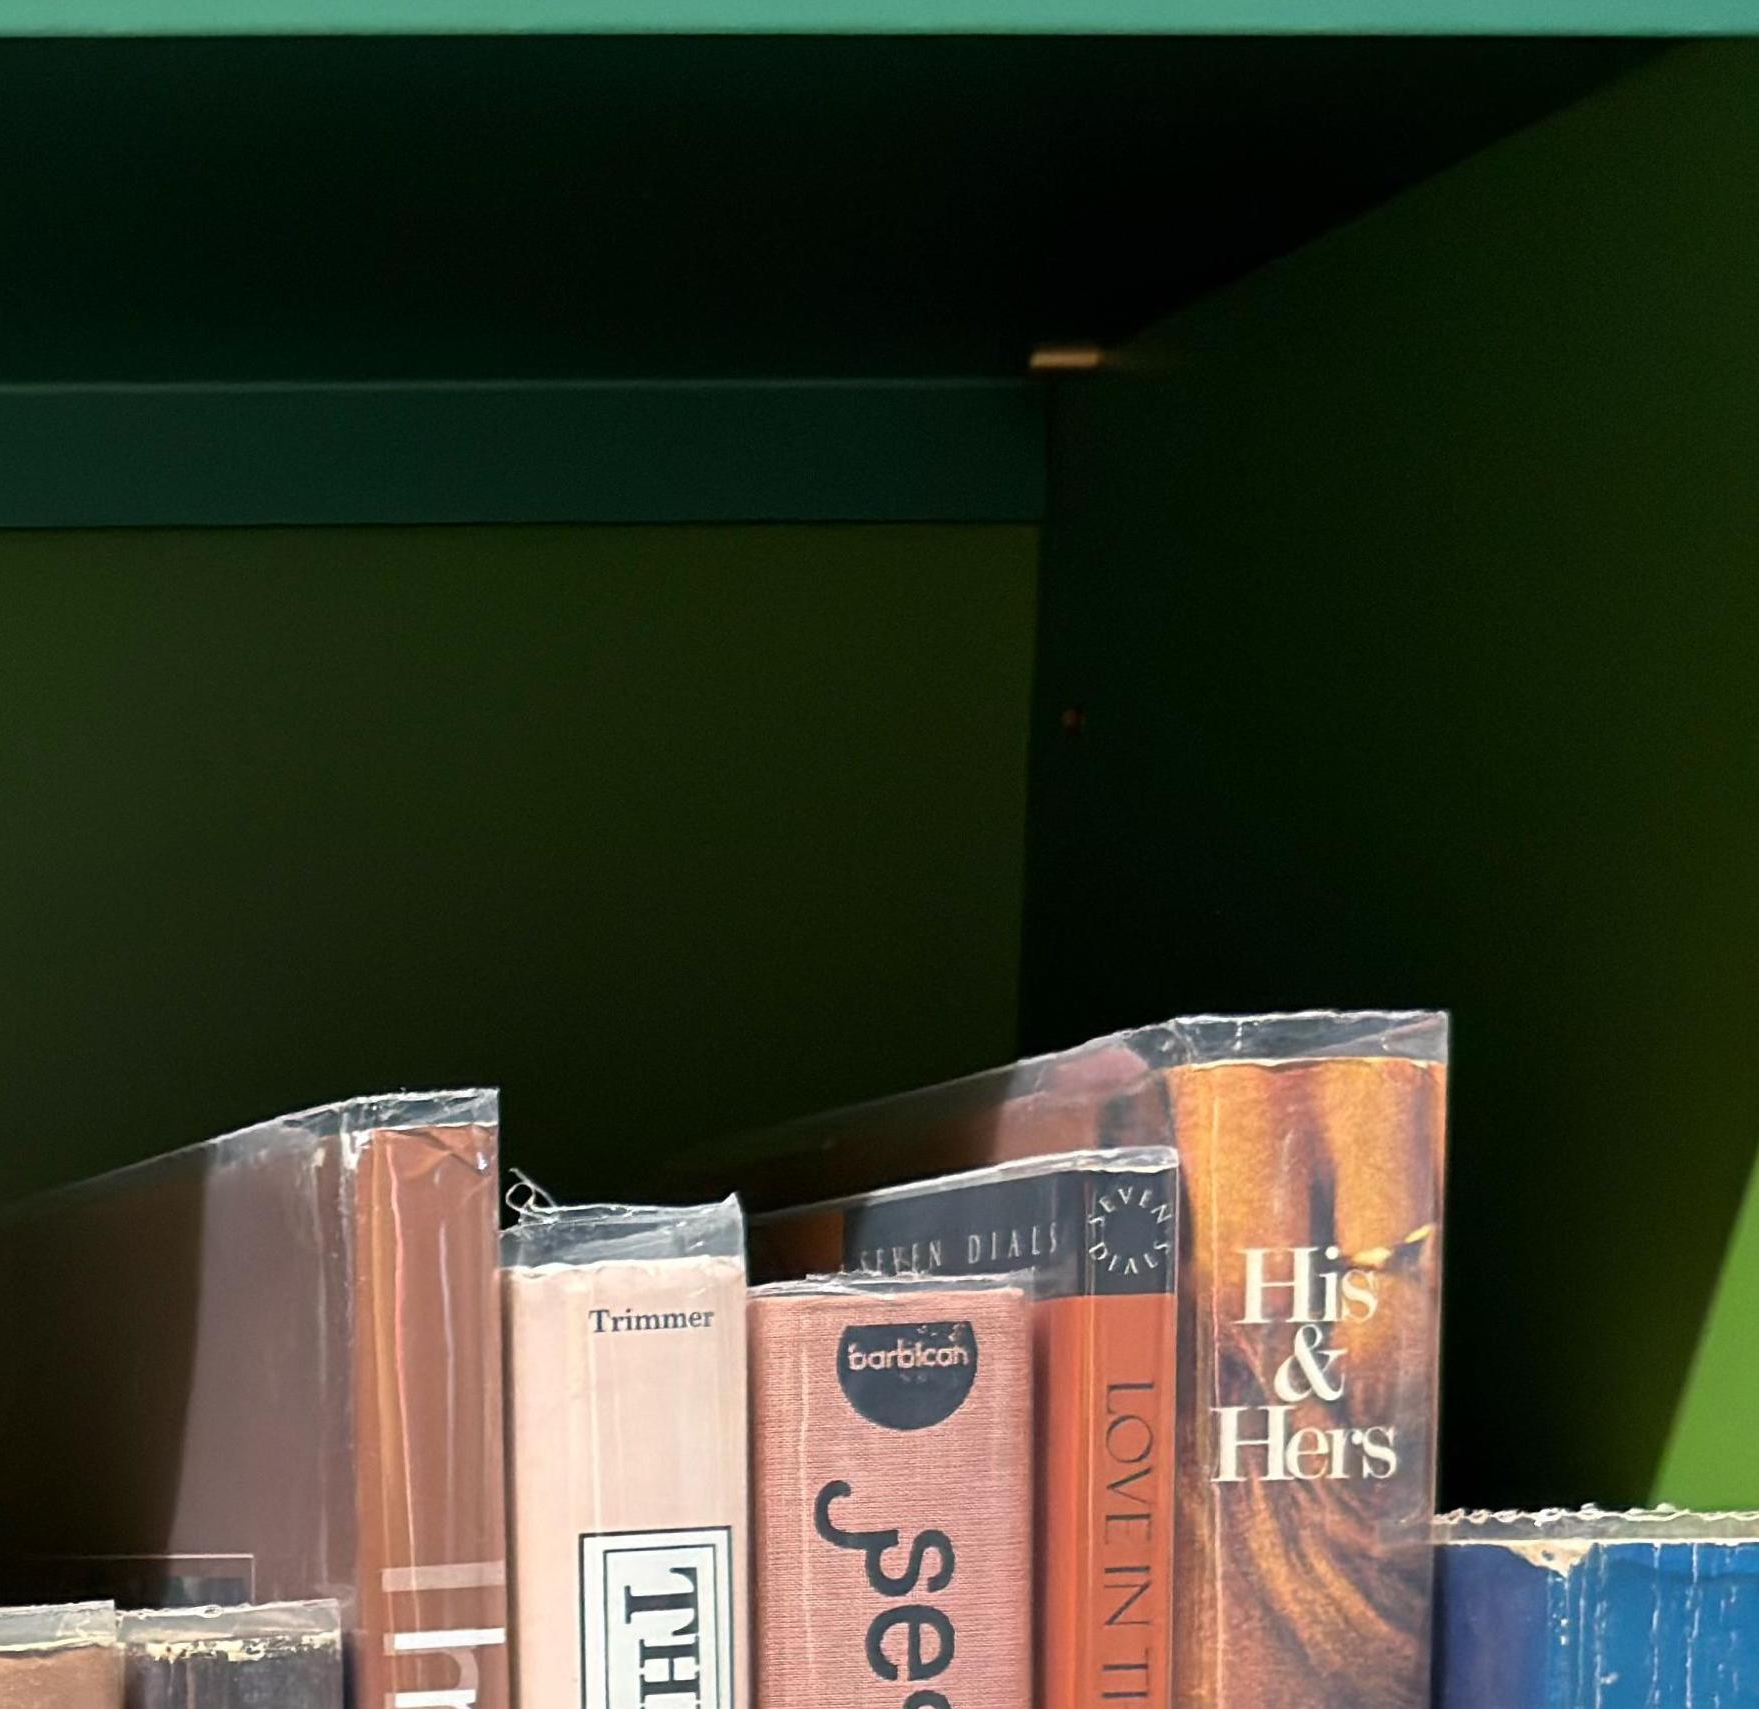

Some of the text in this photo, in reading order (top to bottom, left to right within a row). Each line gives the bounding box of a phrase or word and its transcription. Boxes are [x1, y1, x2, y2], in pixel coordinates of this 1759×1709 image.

[588, 1308, 715, 1333] Trimmer
[1232, 1246, 1379, 1324] His
[848, 1338, 970, 1373] barbican
[1274, 1324, 1348, 1402] &
[1104, 1380, 1154, 1544] LOVE
[1210, 1405, 1397, 1482] Hers
